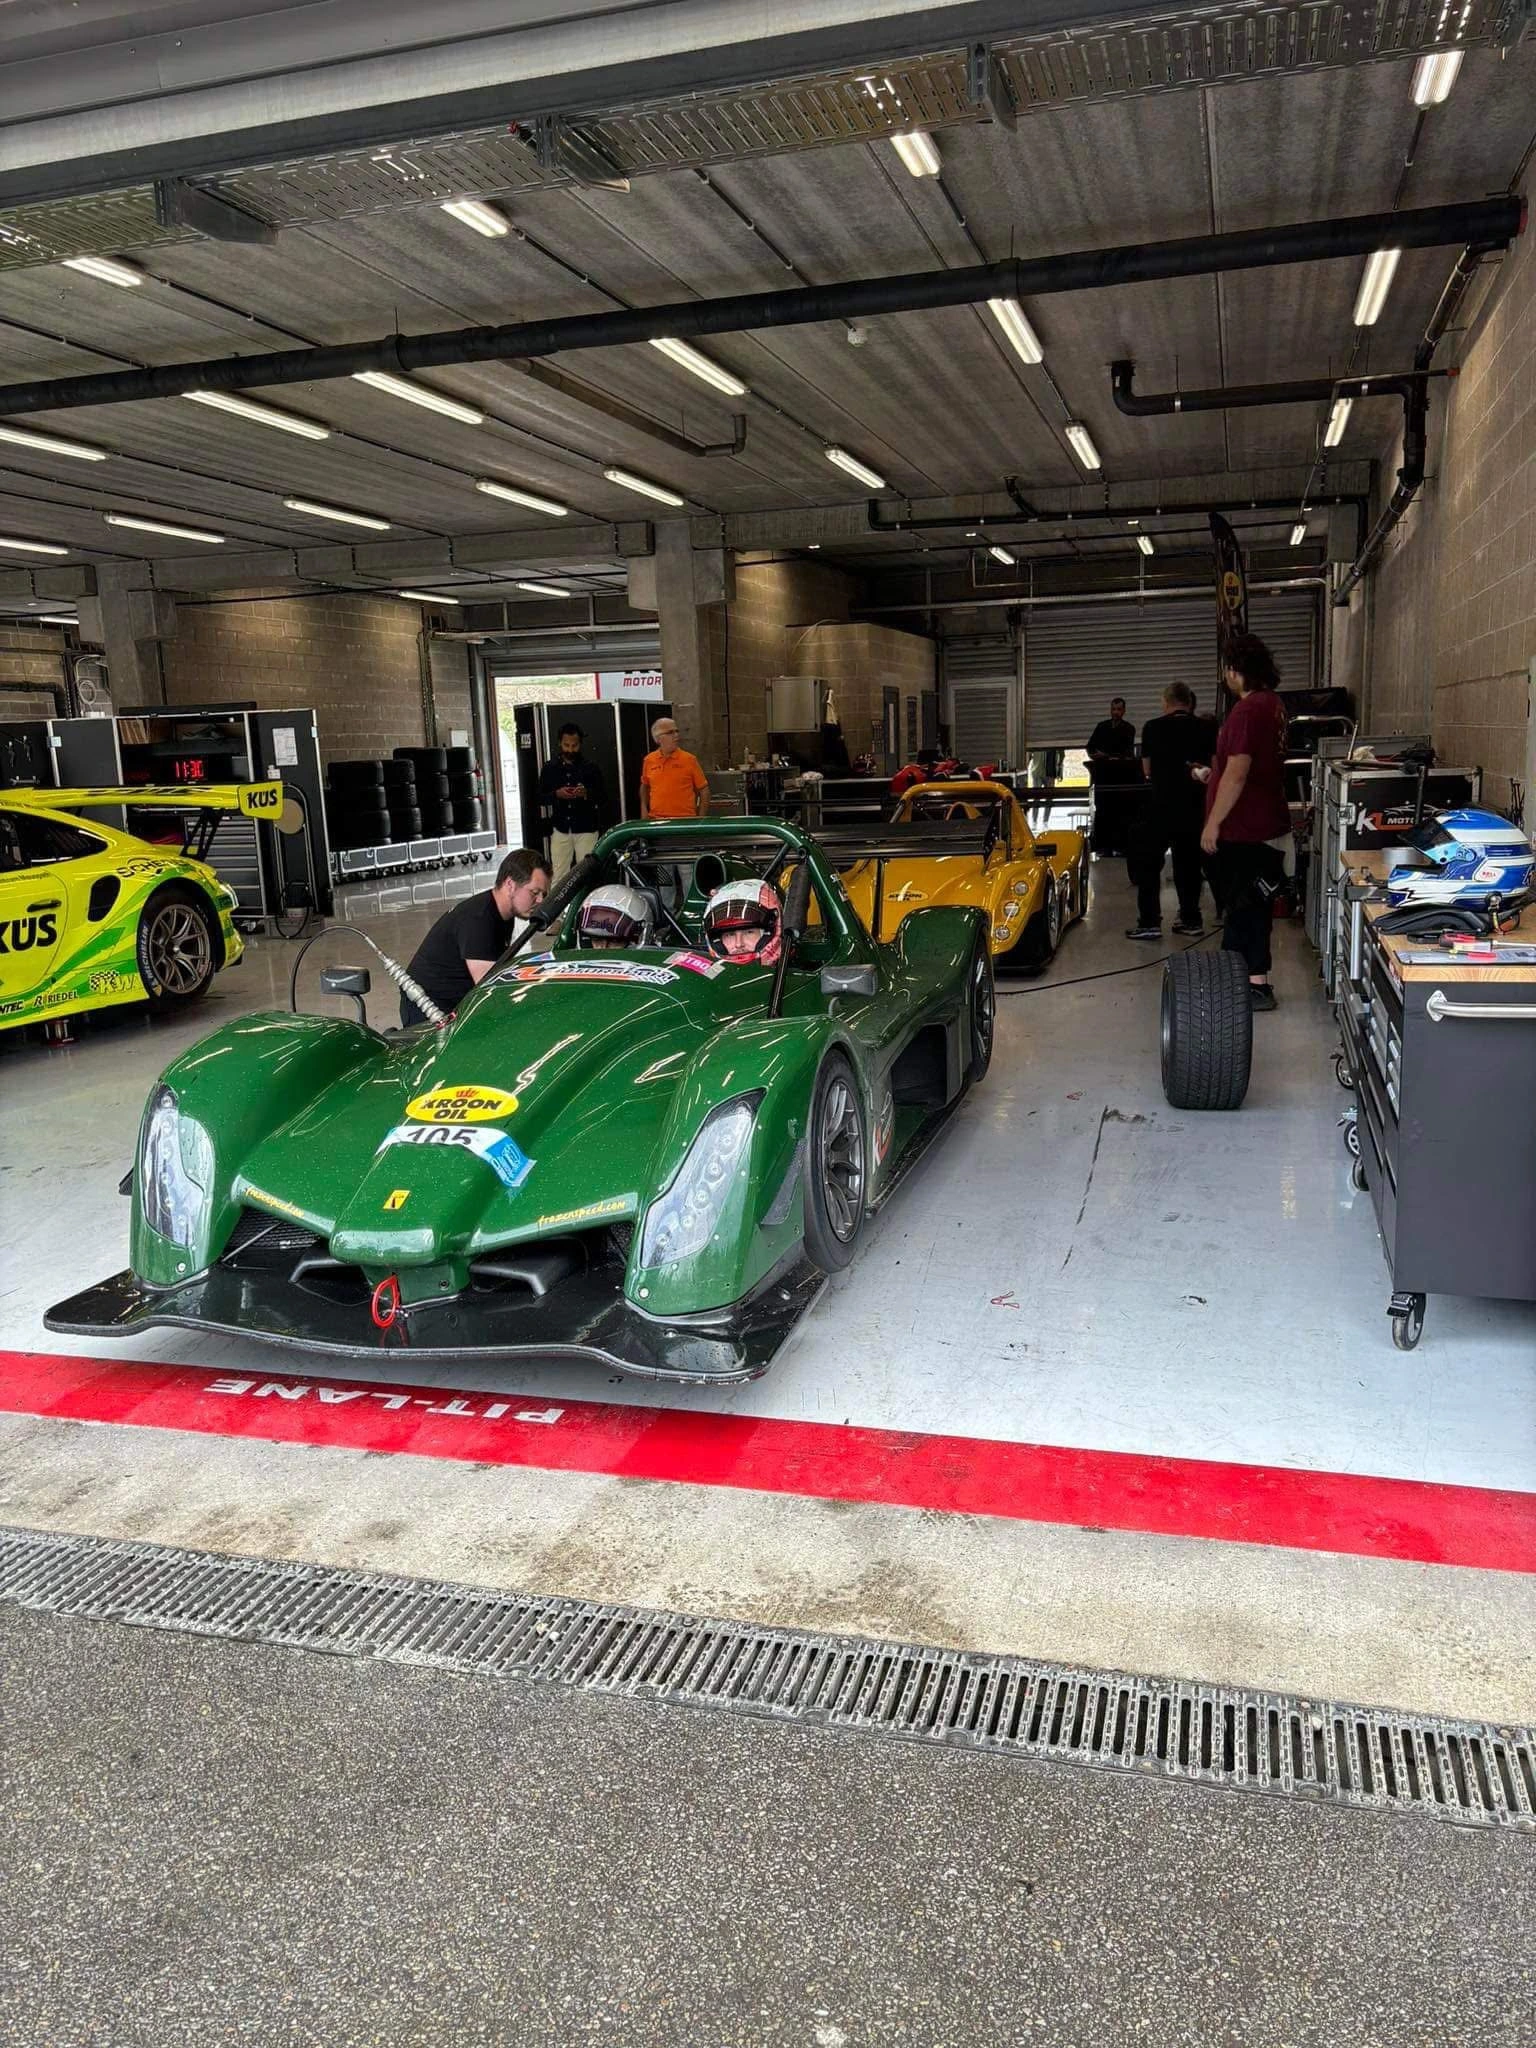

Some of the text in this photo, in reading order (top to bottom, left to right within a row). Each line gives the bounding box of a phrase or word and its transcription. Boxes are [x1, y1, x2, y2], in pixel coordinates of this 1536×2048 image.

[623, 676, 662, 687] MOTOR
[141, 925, 153, 979] MICHELIN
[48, 991, 78, 1003] RIEDEL
[420, 1098, 502, 1110] KROON
[434, 1109, 468, 1120] OIL
[204, 1377, 566, 1425] PIT-LANE
